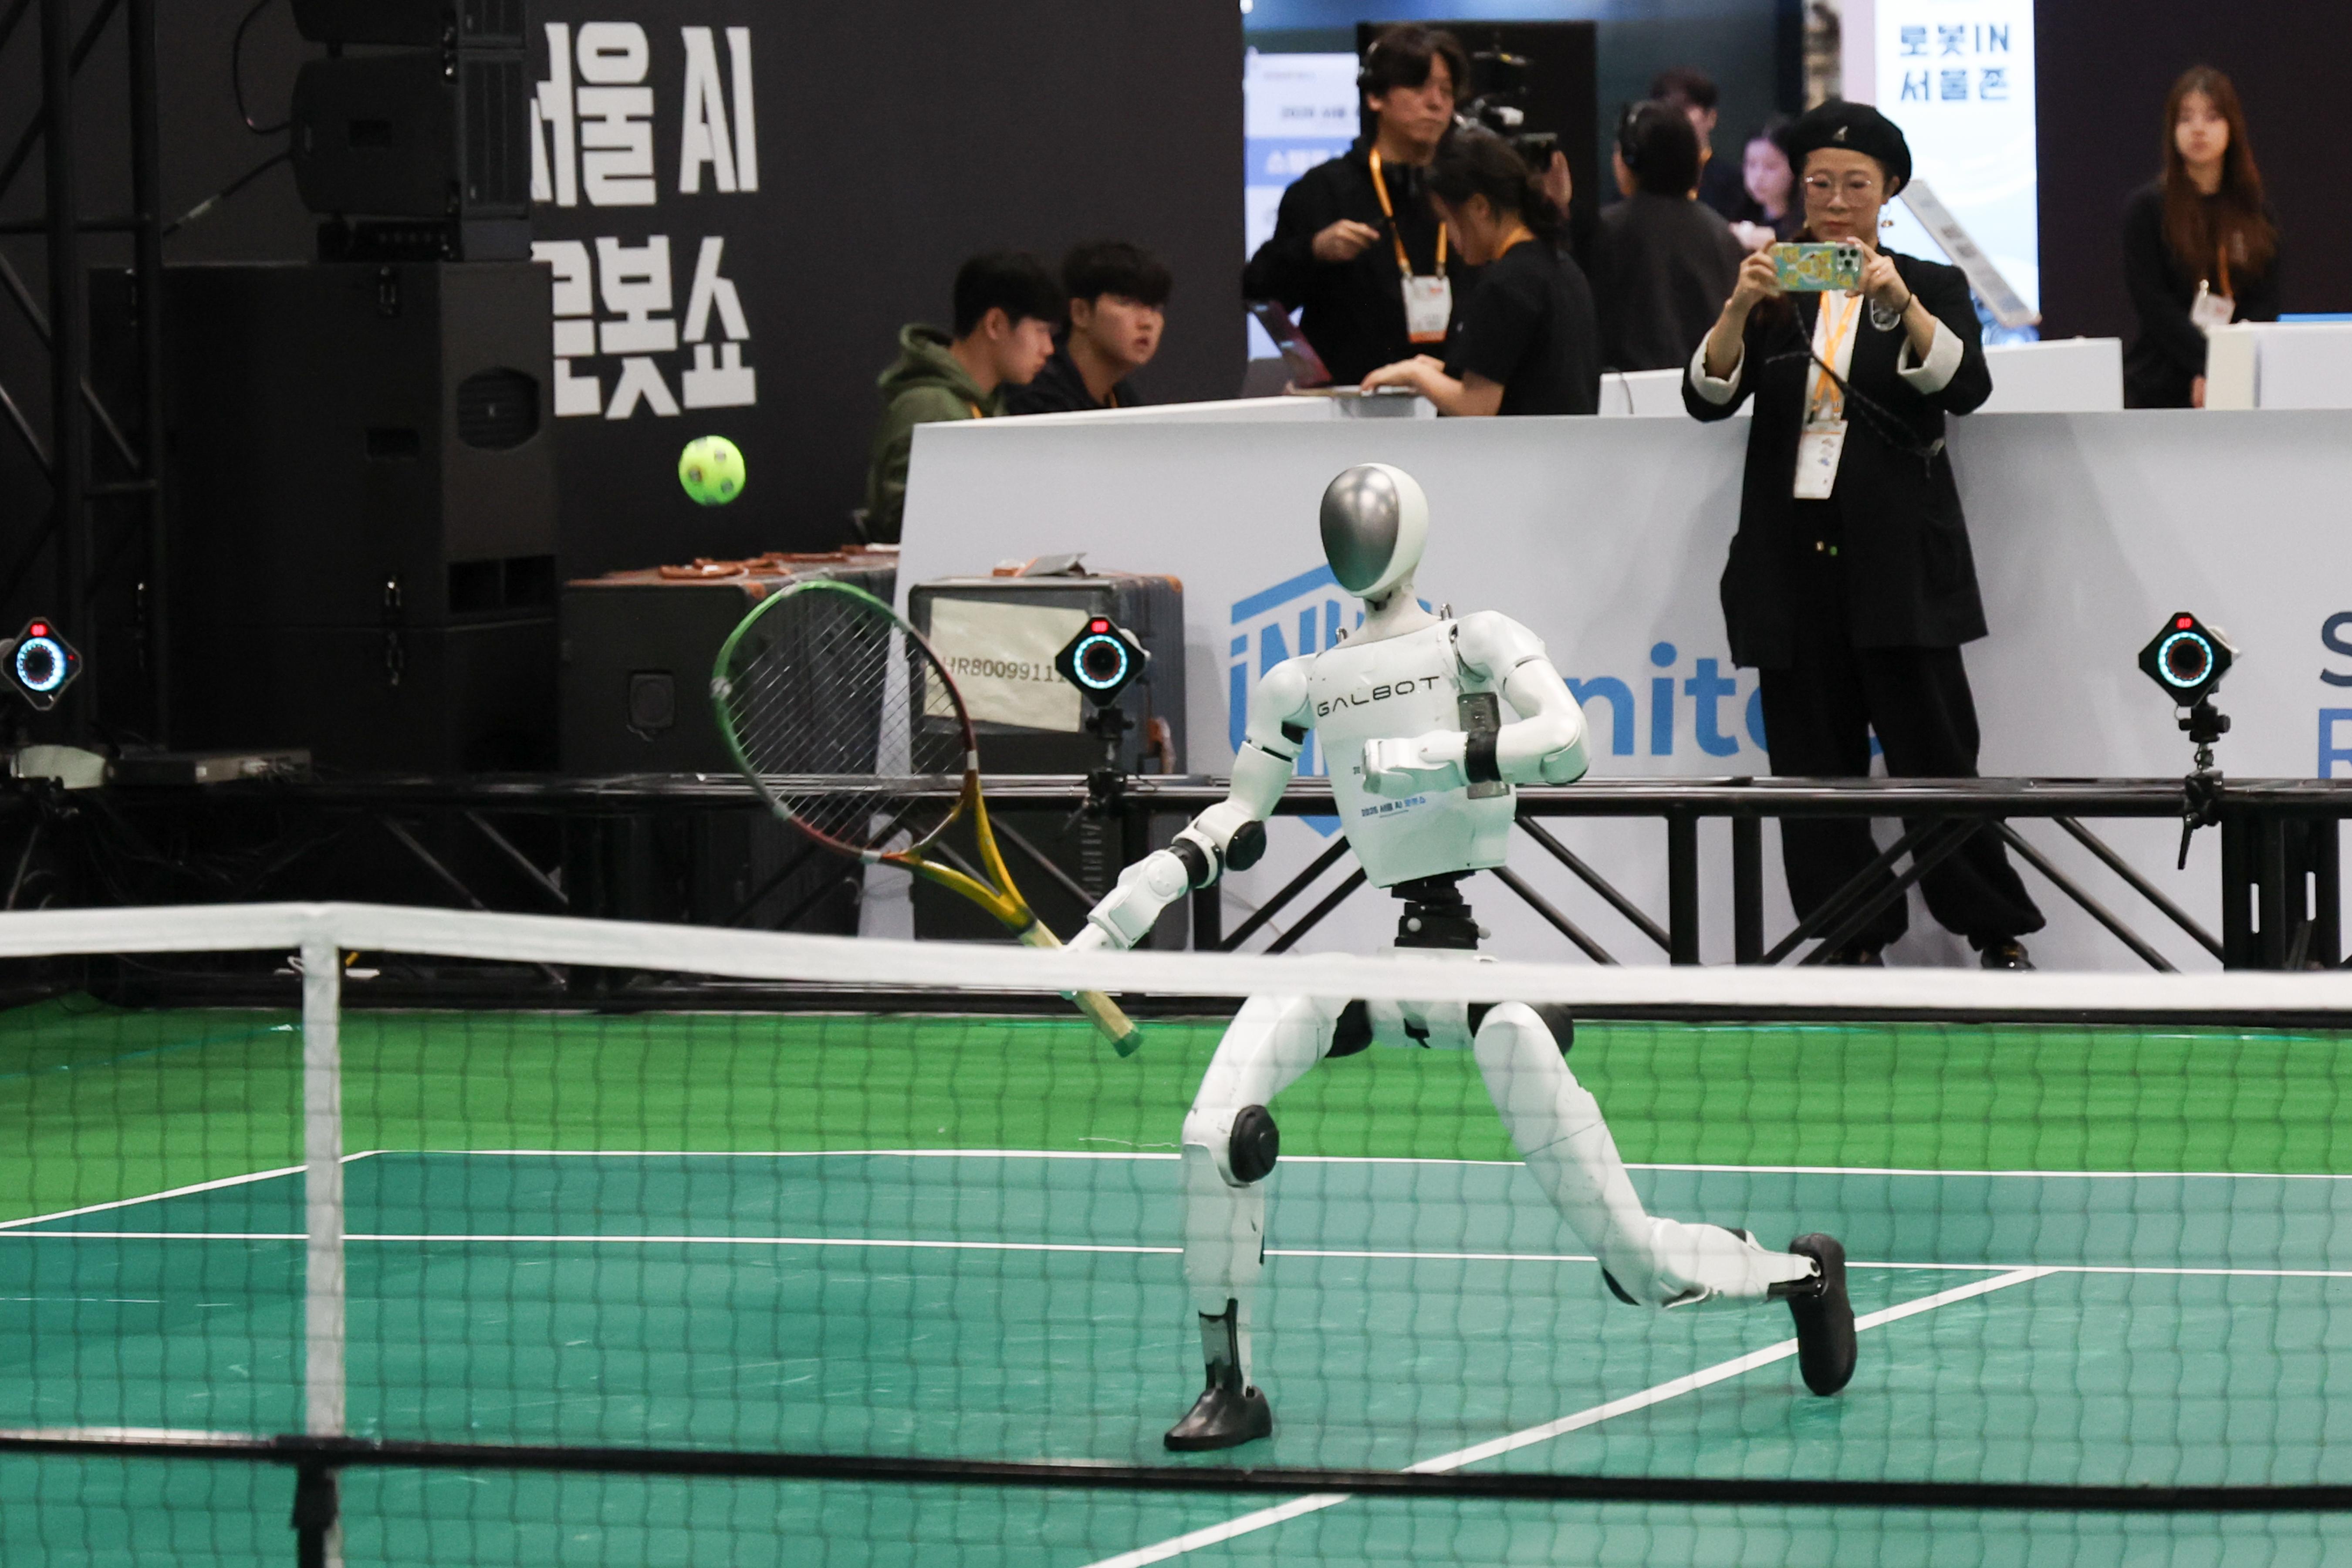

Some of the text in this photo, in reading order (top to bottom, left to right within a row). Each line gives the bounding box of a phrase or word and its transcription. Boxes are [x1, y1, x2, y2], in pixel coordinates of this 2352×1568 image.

[1900, 24, 2010, 57] 로봇IN
[1900, 68, 2009, 101] 서울존
[1317, 676, 1440, 717] GALBOT
